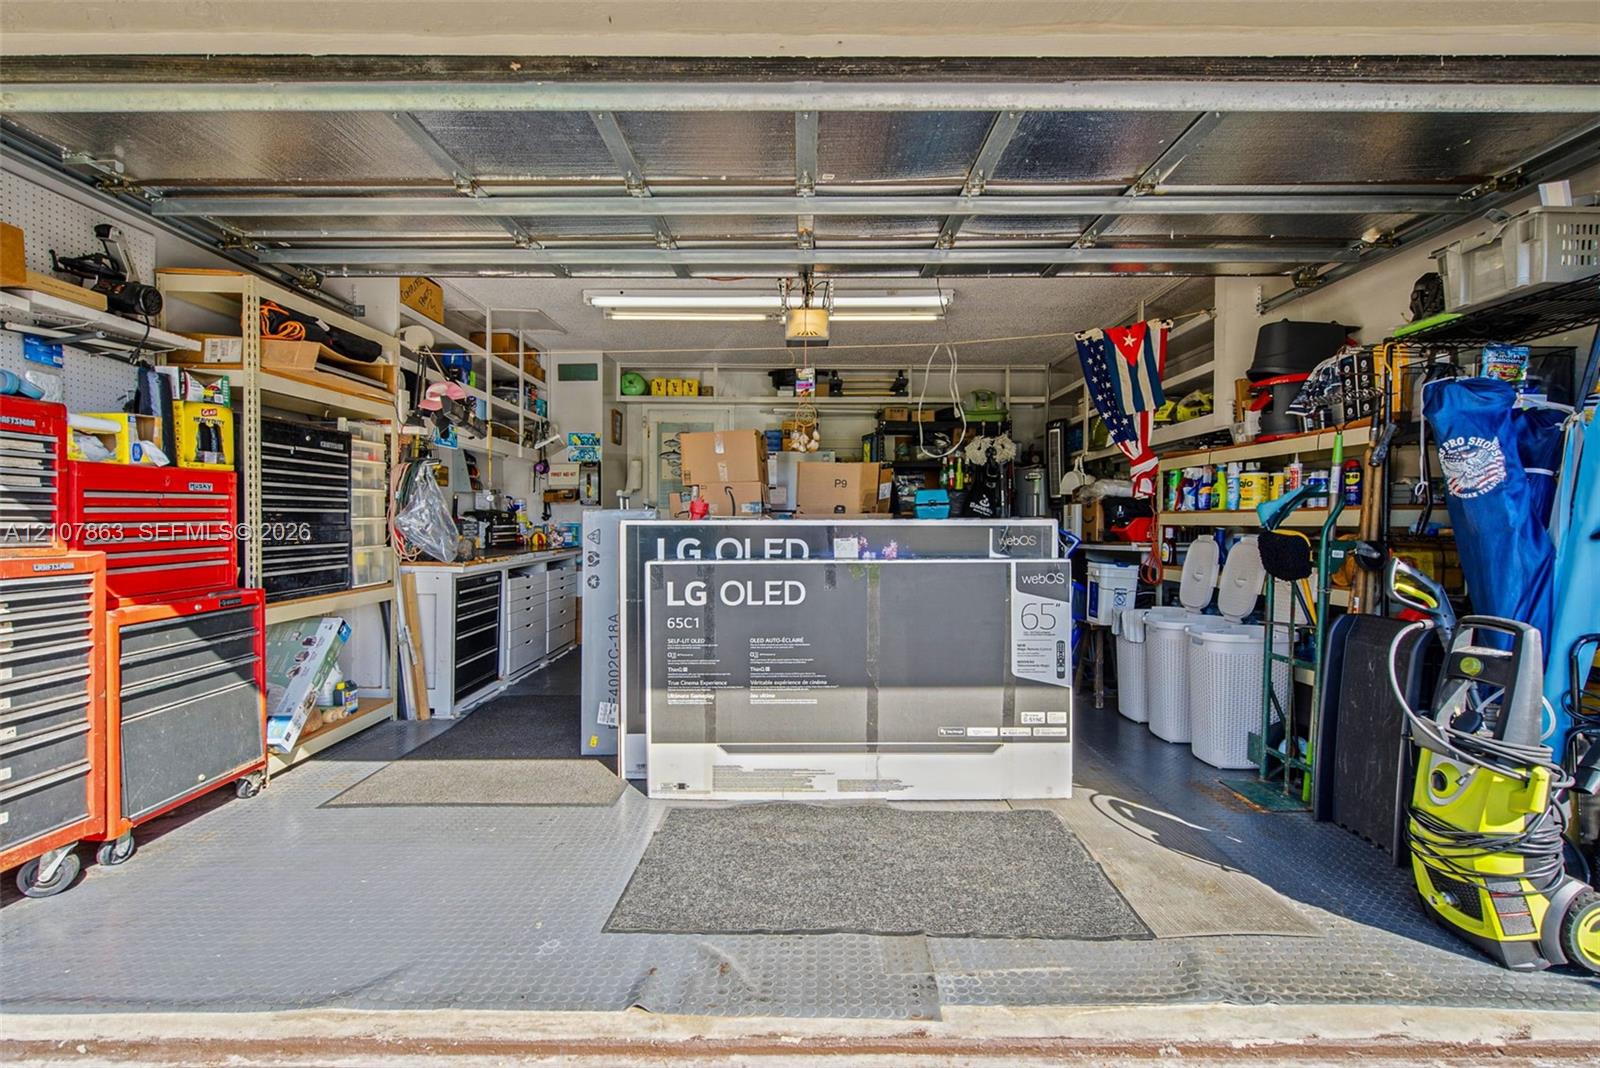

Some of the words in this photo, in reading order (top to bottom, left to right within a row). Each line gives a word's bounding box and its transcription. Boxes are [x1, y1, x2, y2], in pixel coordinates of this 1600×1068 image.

[1443, 436, 1465, 450] PRO
[1468, 436, 1501, 457] SHOPS
[834, 479, 848, 488] P9
[999, 535, 1038, 546] webOS
[657, 538, 701, 560] LG
[715, 538, 810, 560] OLED
[1021, 573, 1065, 585] webOS
[667, 581, 707, 607] LG
[720, 580, 807, 607] OLED
[667, 617, 700, 629] 65C1
[690, 692, 715, 700] Gameplay
